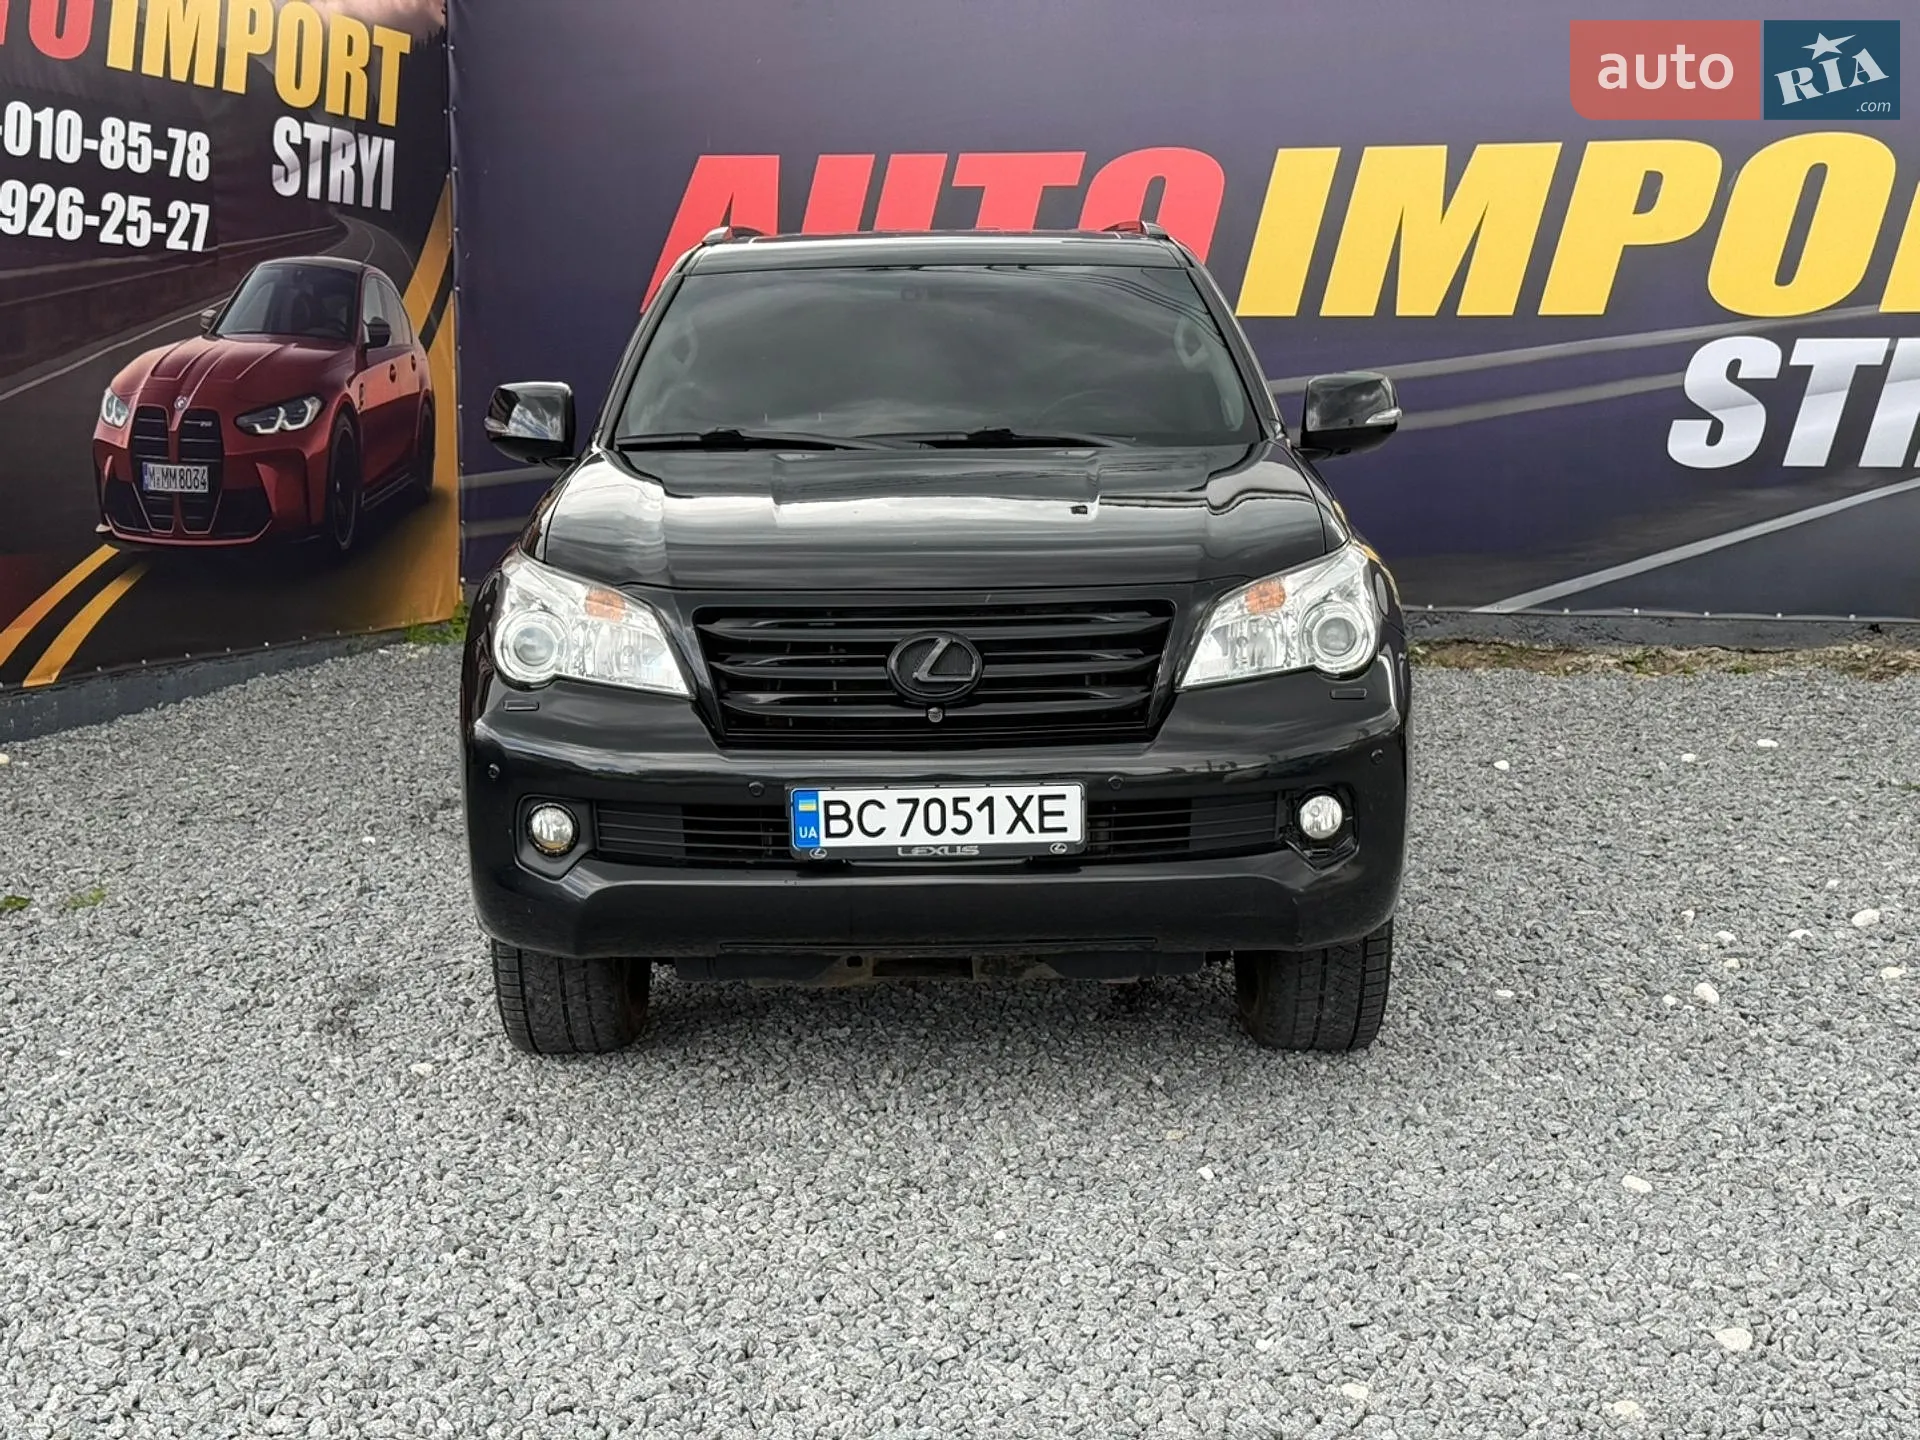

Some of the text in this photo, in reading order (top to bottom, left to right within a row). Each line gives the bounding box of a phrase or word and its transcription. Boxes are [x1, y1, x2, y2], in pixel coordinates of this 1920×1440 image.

[107, 0, 412, 127] IMPORT
[0, 101, 210, 182] 010-85-78
[271, 116, 395, 211] STRYI
[0, 179, 210, 252] 926-25-27
[799, 826, 818, 839] UA
[897, 845, 980, 857] LEXUS
